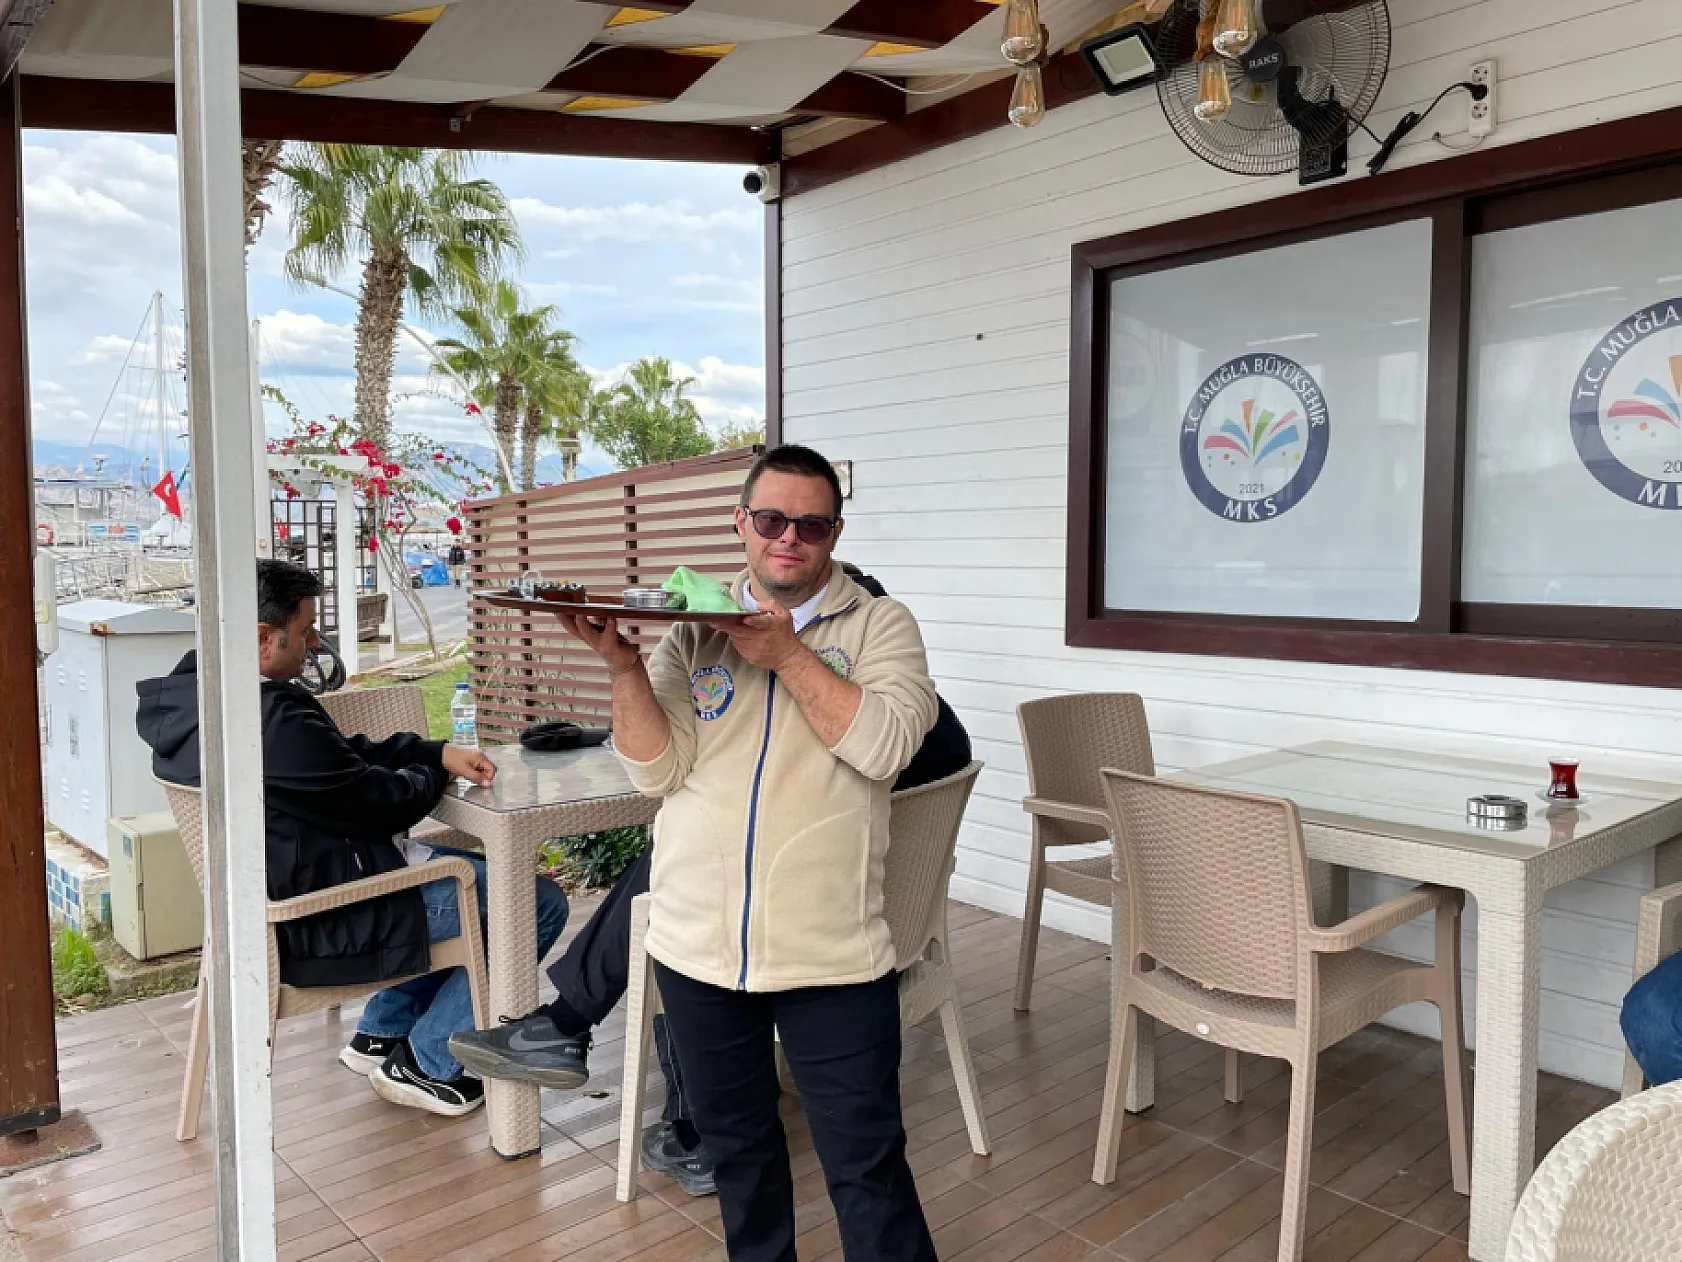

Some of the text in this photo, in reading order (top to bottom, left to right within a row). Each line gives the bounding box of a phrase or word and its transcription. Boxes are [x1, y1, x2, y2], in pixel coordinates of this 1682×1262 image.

[1600, 304, 1680, 361] MUĞLA
[1200, 360, 1248, 403] MUĞLA
[1239, 483, 1265, 495] 2021
[1224, 499, 1277, 520] MKS
